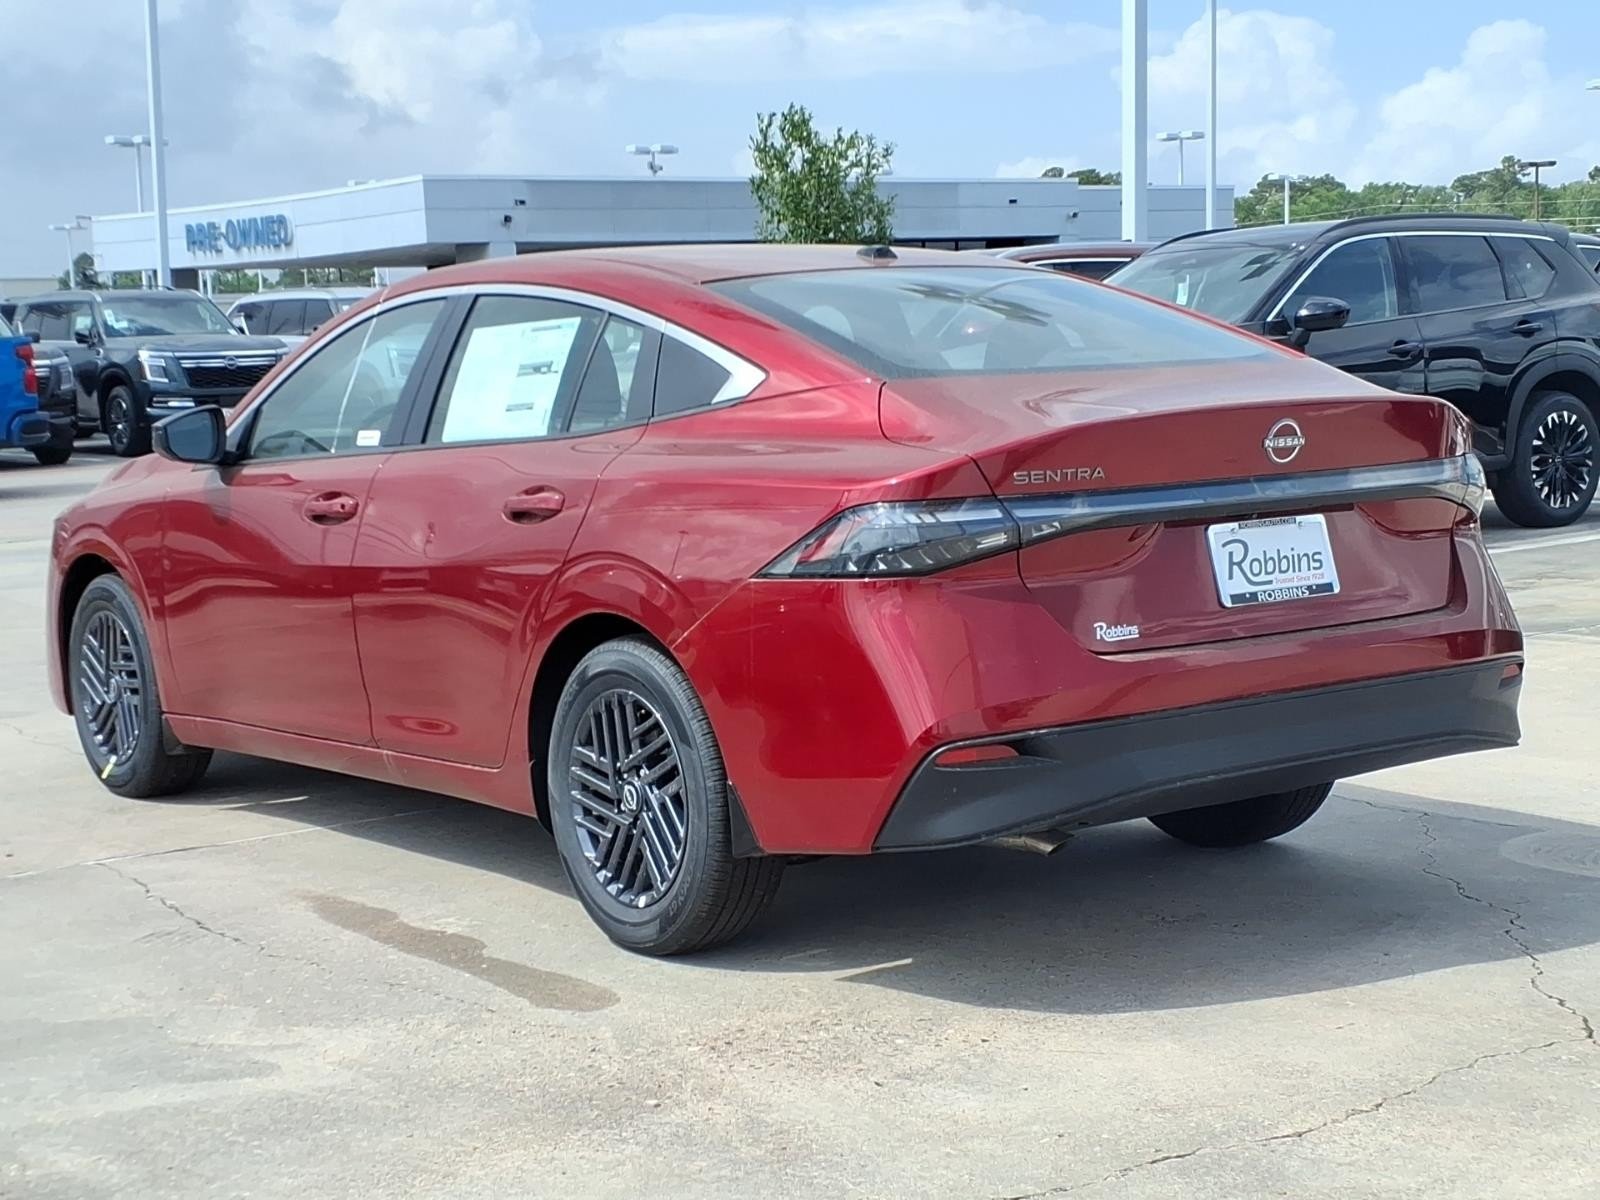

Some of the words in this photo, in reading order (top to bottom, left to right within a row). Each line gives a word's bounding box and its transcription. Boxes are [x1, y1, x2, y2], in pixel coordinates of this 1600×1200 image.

[185, 214, 292, 254] PRE-OWNED
[1265, 437, 1305, 447] NISSAN
[1013, 467, 1105, 484] SENTRA
[1221, 538, 1323, 586] Robbins
[1257, 586, 1310, 602] ROBBINS
[1093, 622, 1140, 642] Robbins
